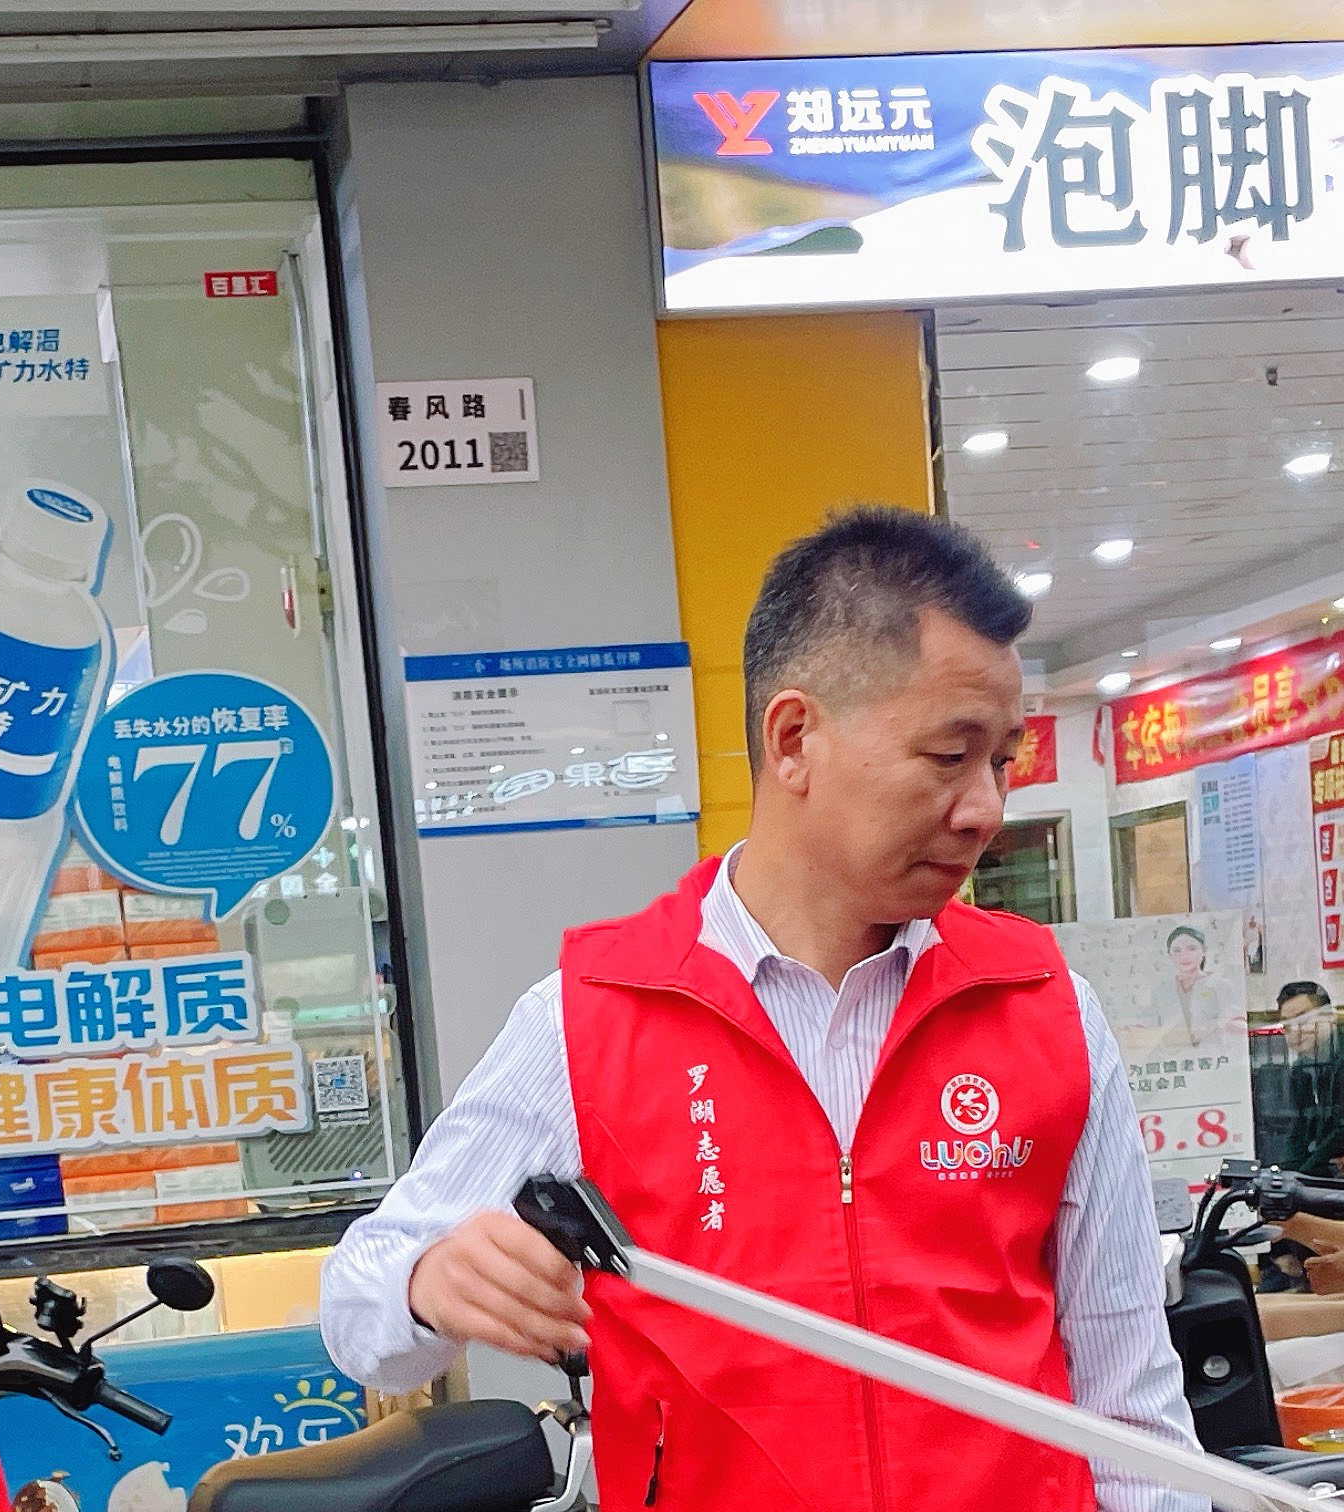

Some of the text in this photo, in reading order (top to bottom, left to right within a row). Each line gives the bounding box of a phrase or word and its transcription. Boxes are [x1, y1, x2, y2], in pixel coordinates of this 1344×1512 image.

[786, 88, 933, 132] 郑远元
[789, 134, 935, 155] ZHENGYUANYUAN
[389, 393, 486, 421] 春风路
[398, 438, 484, 471] 2011
[114, 705, 289, 740] 丢失水分的恢复率
[687, 1063, 726, 1232] 罗湖志愿者
